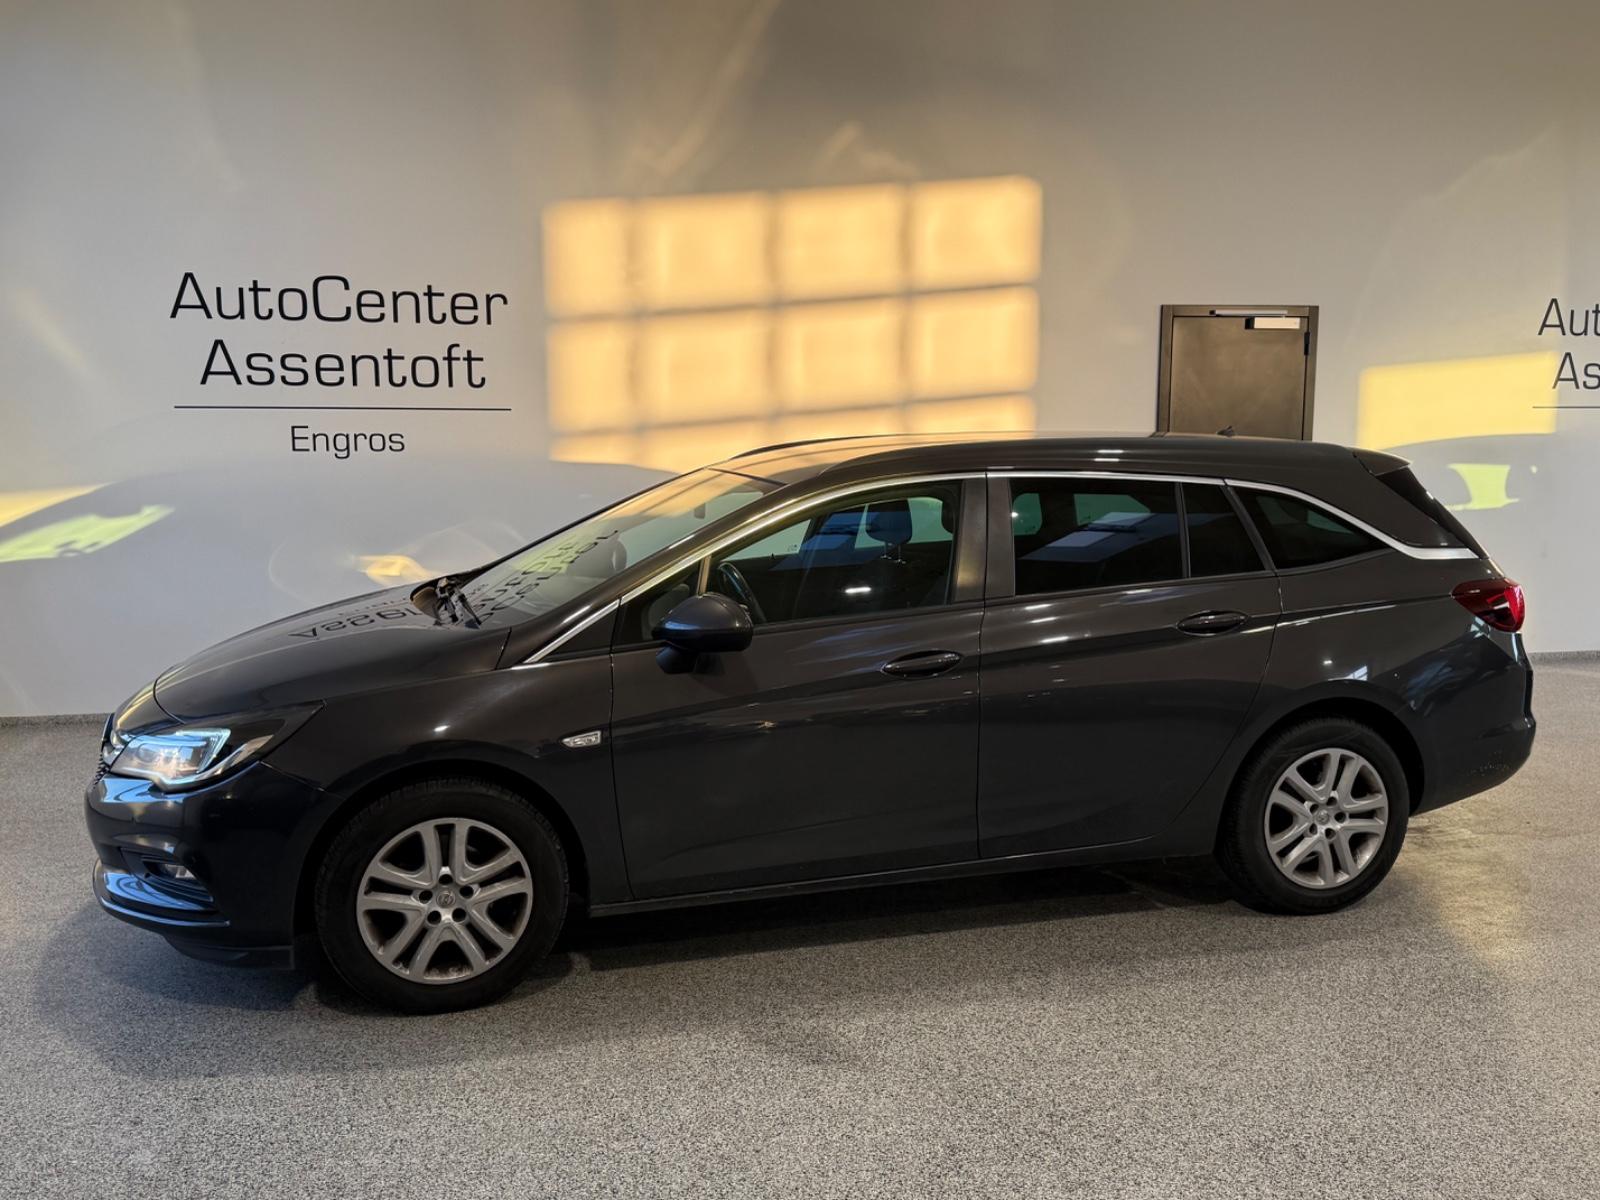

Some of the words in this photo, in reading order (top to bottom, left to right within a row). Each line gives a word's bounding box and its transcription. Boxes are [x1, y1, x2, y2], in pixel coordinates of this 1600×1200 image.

[170, 271, 508, 326] AutoCenter
[200, 339, 486, 389] Assentoft
[1551, 351, 1600, 390] As
[290, 425, 405, 460] Engros
